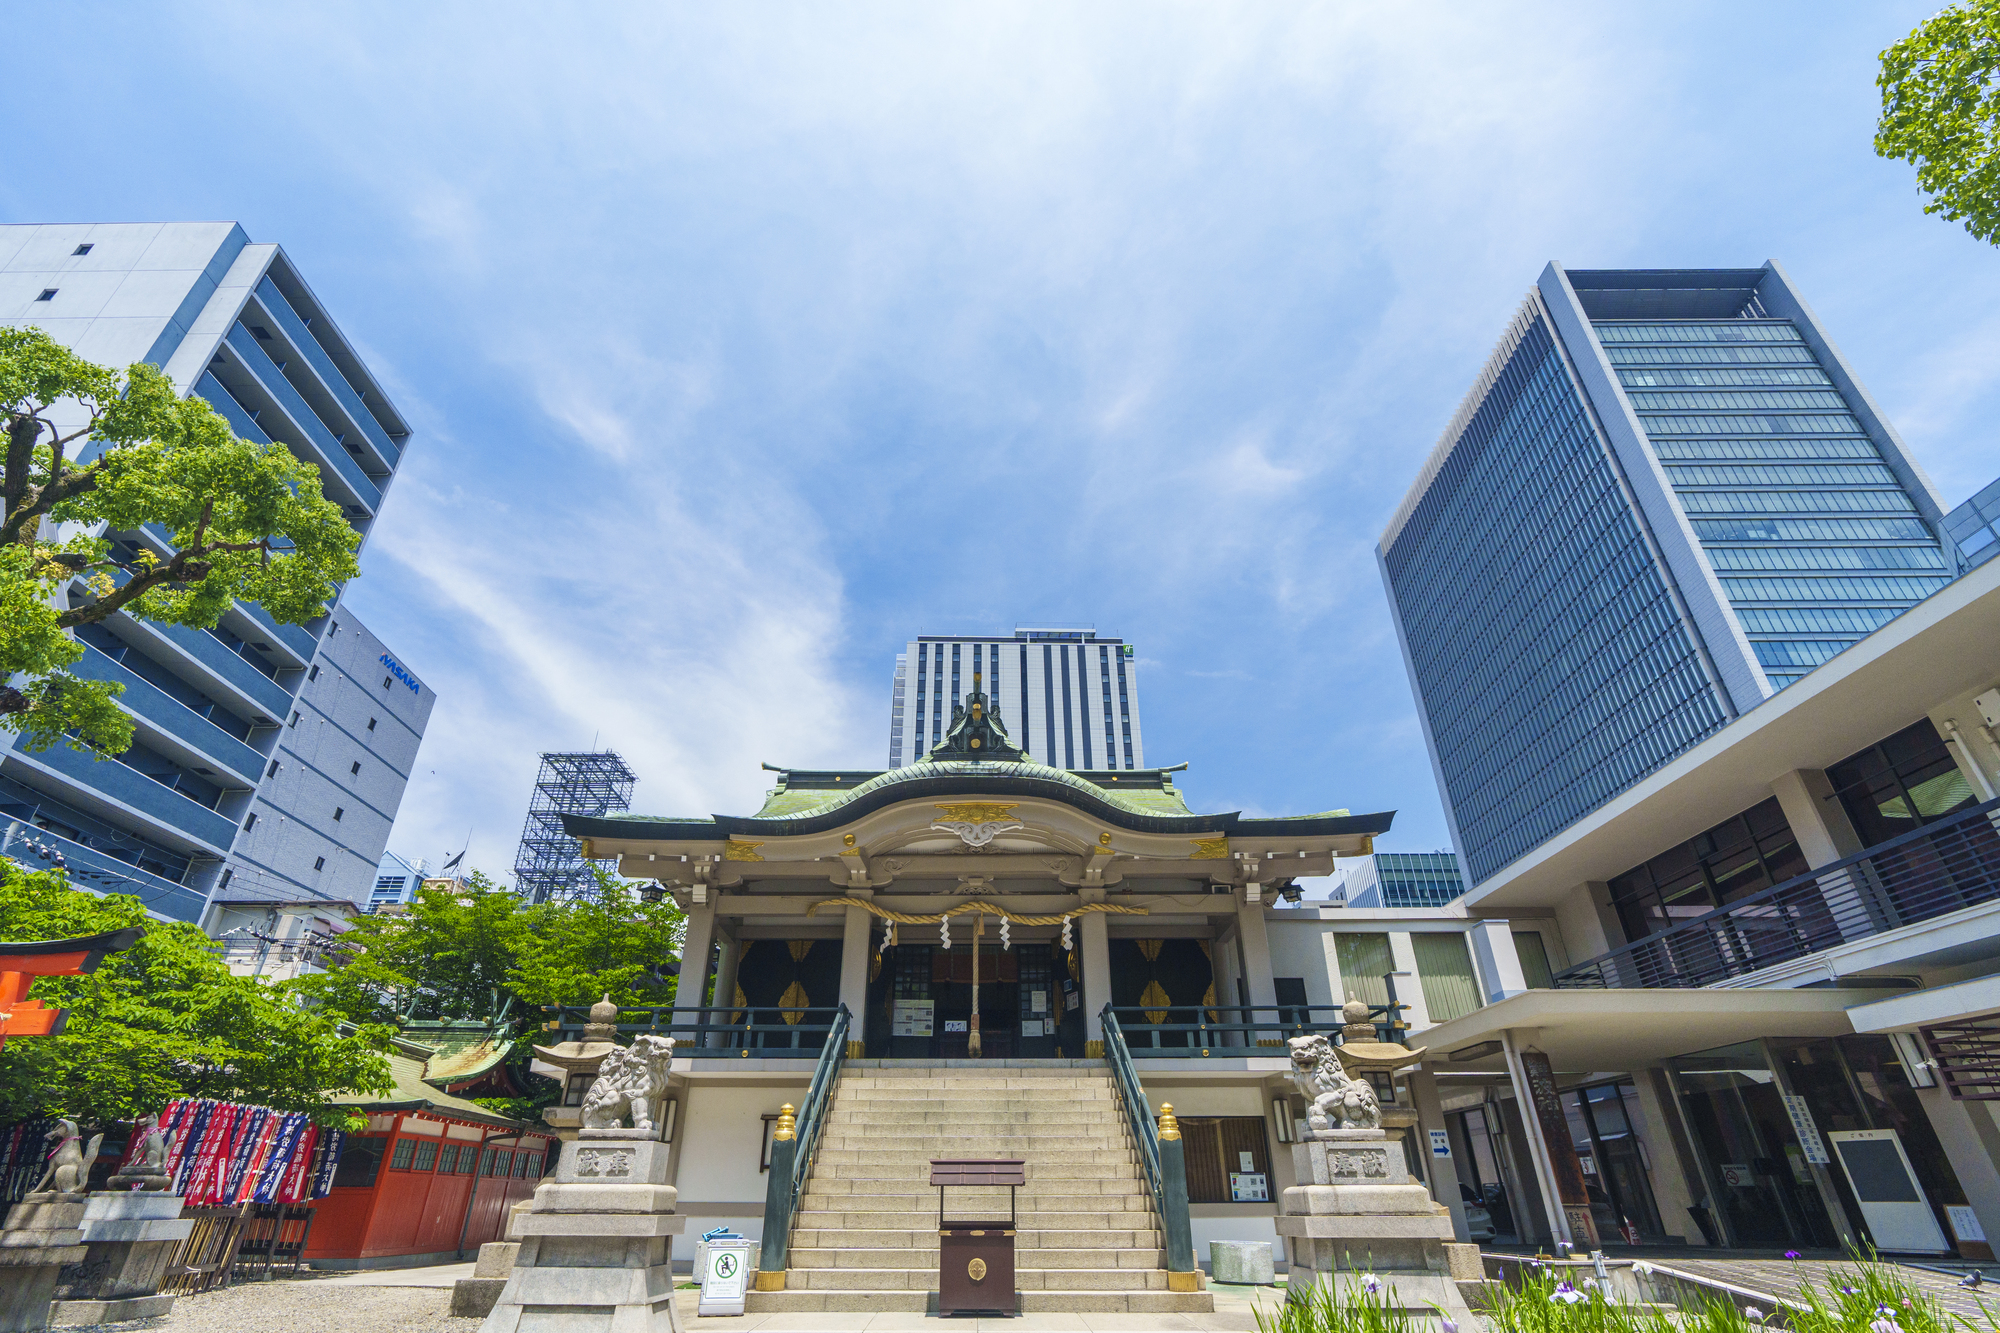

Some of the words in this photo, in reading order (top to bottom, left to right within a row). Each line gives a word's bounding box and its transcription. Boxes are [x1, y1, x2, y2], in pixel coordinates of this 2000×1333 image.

[379, 652, 420, 695] NASAKA
[1785, 1096, 1817, 1162] 定期健康診断会場
